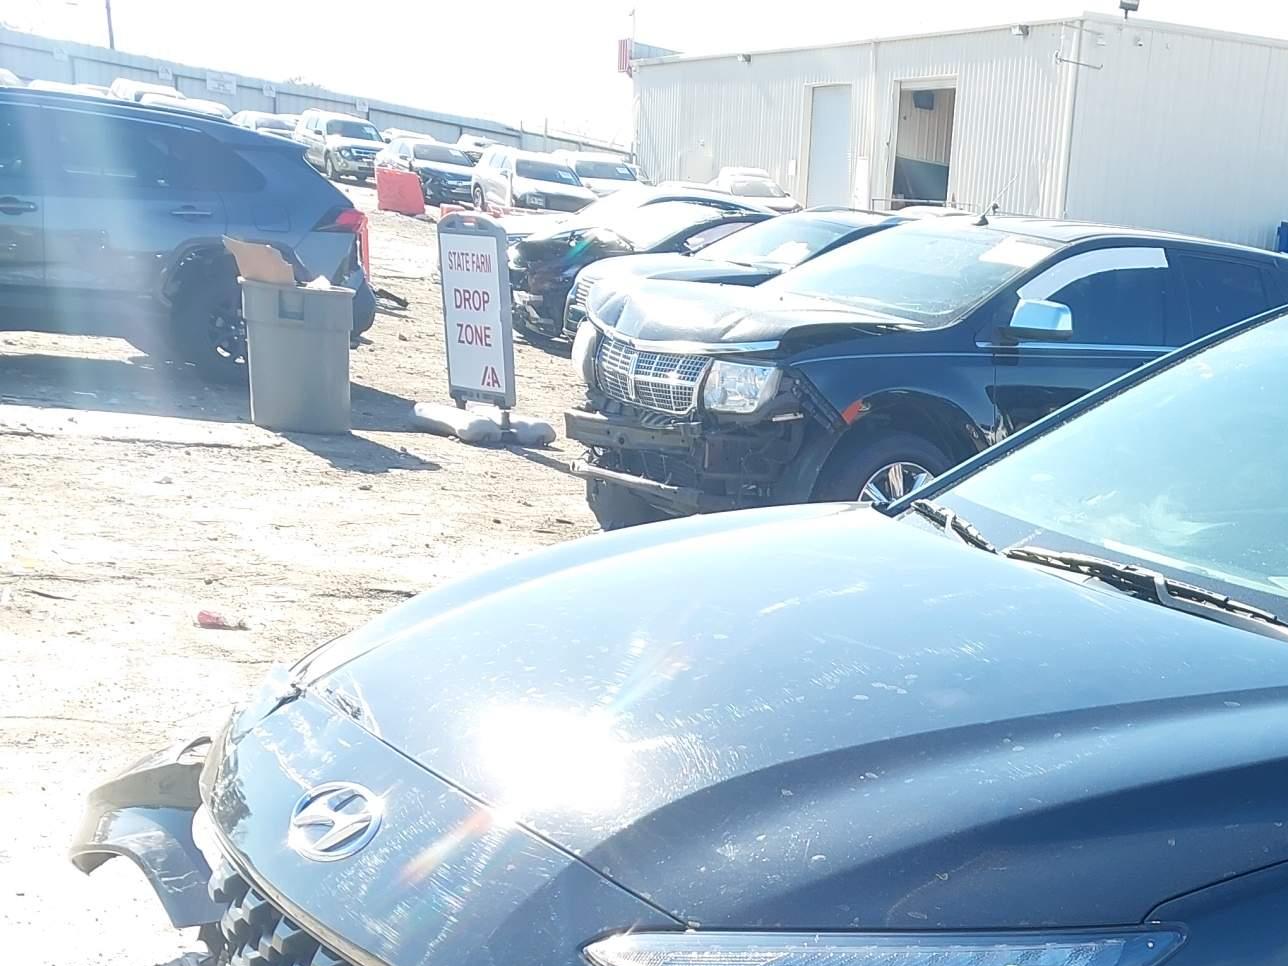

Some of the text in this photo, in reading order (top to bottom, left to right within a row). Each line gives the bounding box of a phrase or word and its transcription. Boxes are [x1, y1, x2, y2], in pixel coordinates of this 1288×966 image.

[448, 251, 492, 273] STATE FARM
[454, 288, 490, 312] DROP
[456, 323, 492, 347] ZONE
